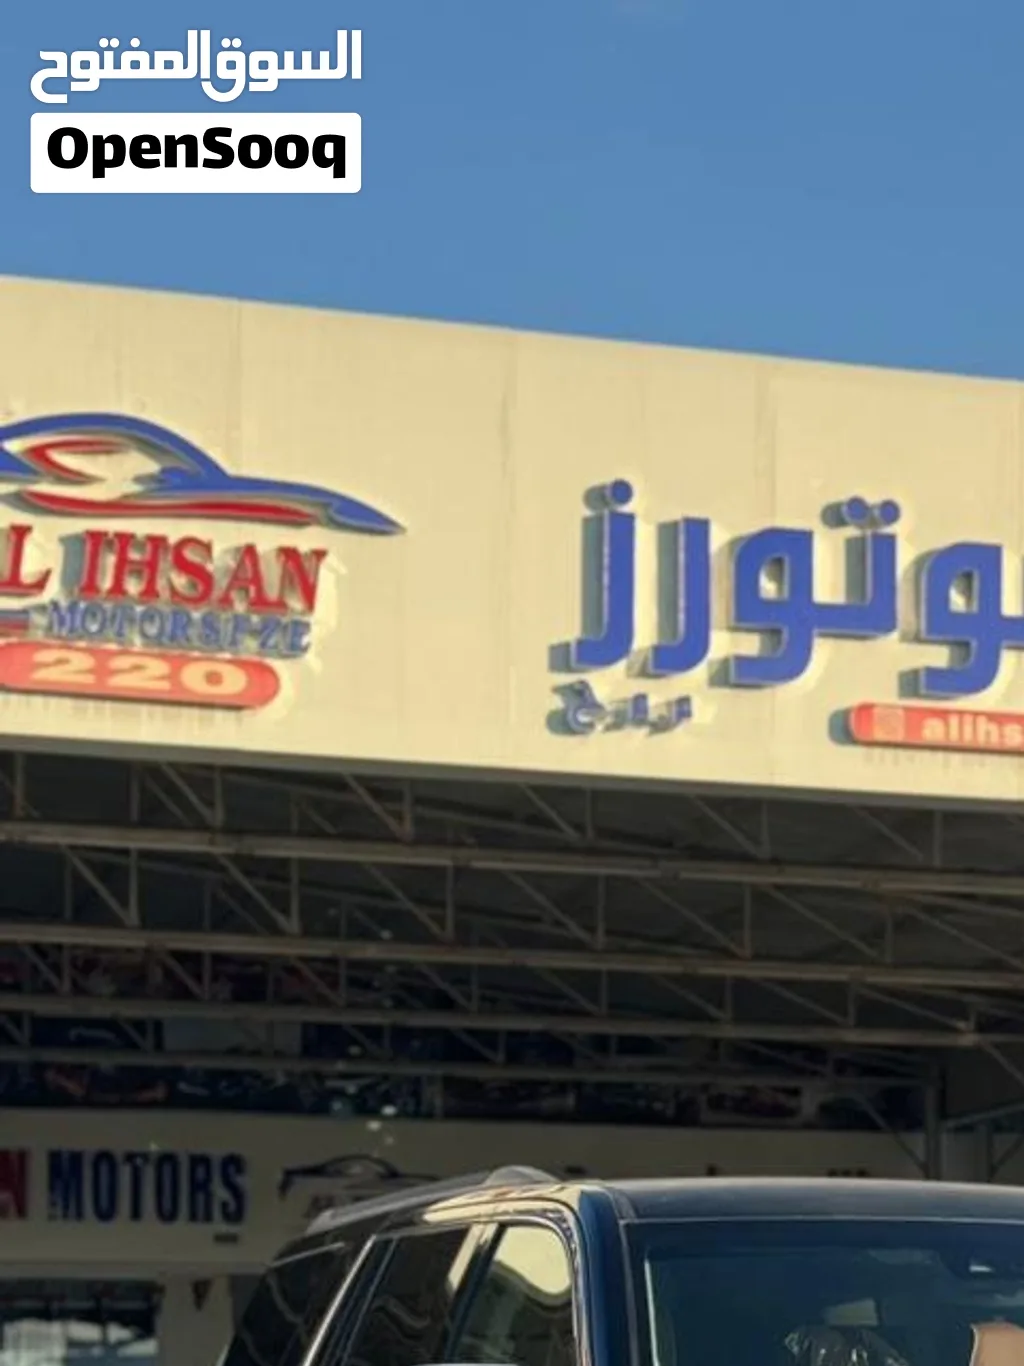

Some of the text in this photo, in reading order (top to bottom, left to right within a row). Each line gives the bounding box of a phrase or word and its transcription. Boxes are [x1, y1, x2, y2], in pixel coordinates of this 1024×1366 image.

[79, 528, 328, 613] IHSAN
[47, 599, 220, 649] MOTORS
[30, 648, 249, 695] 220
[47, 1148, 248, 1225] MOTORS
